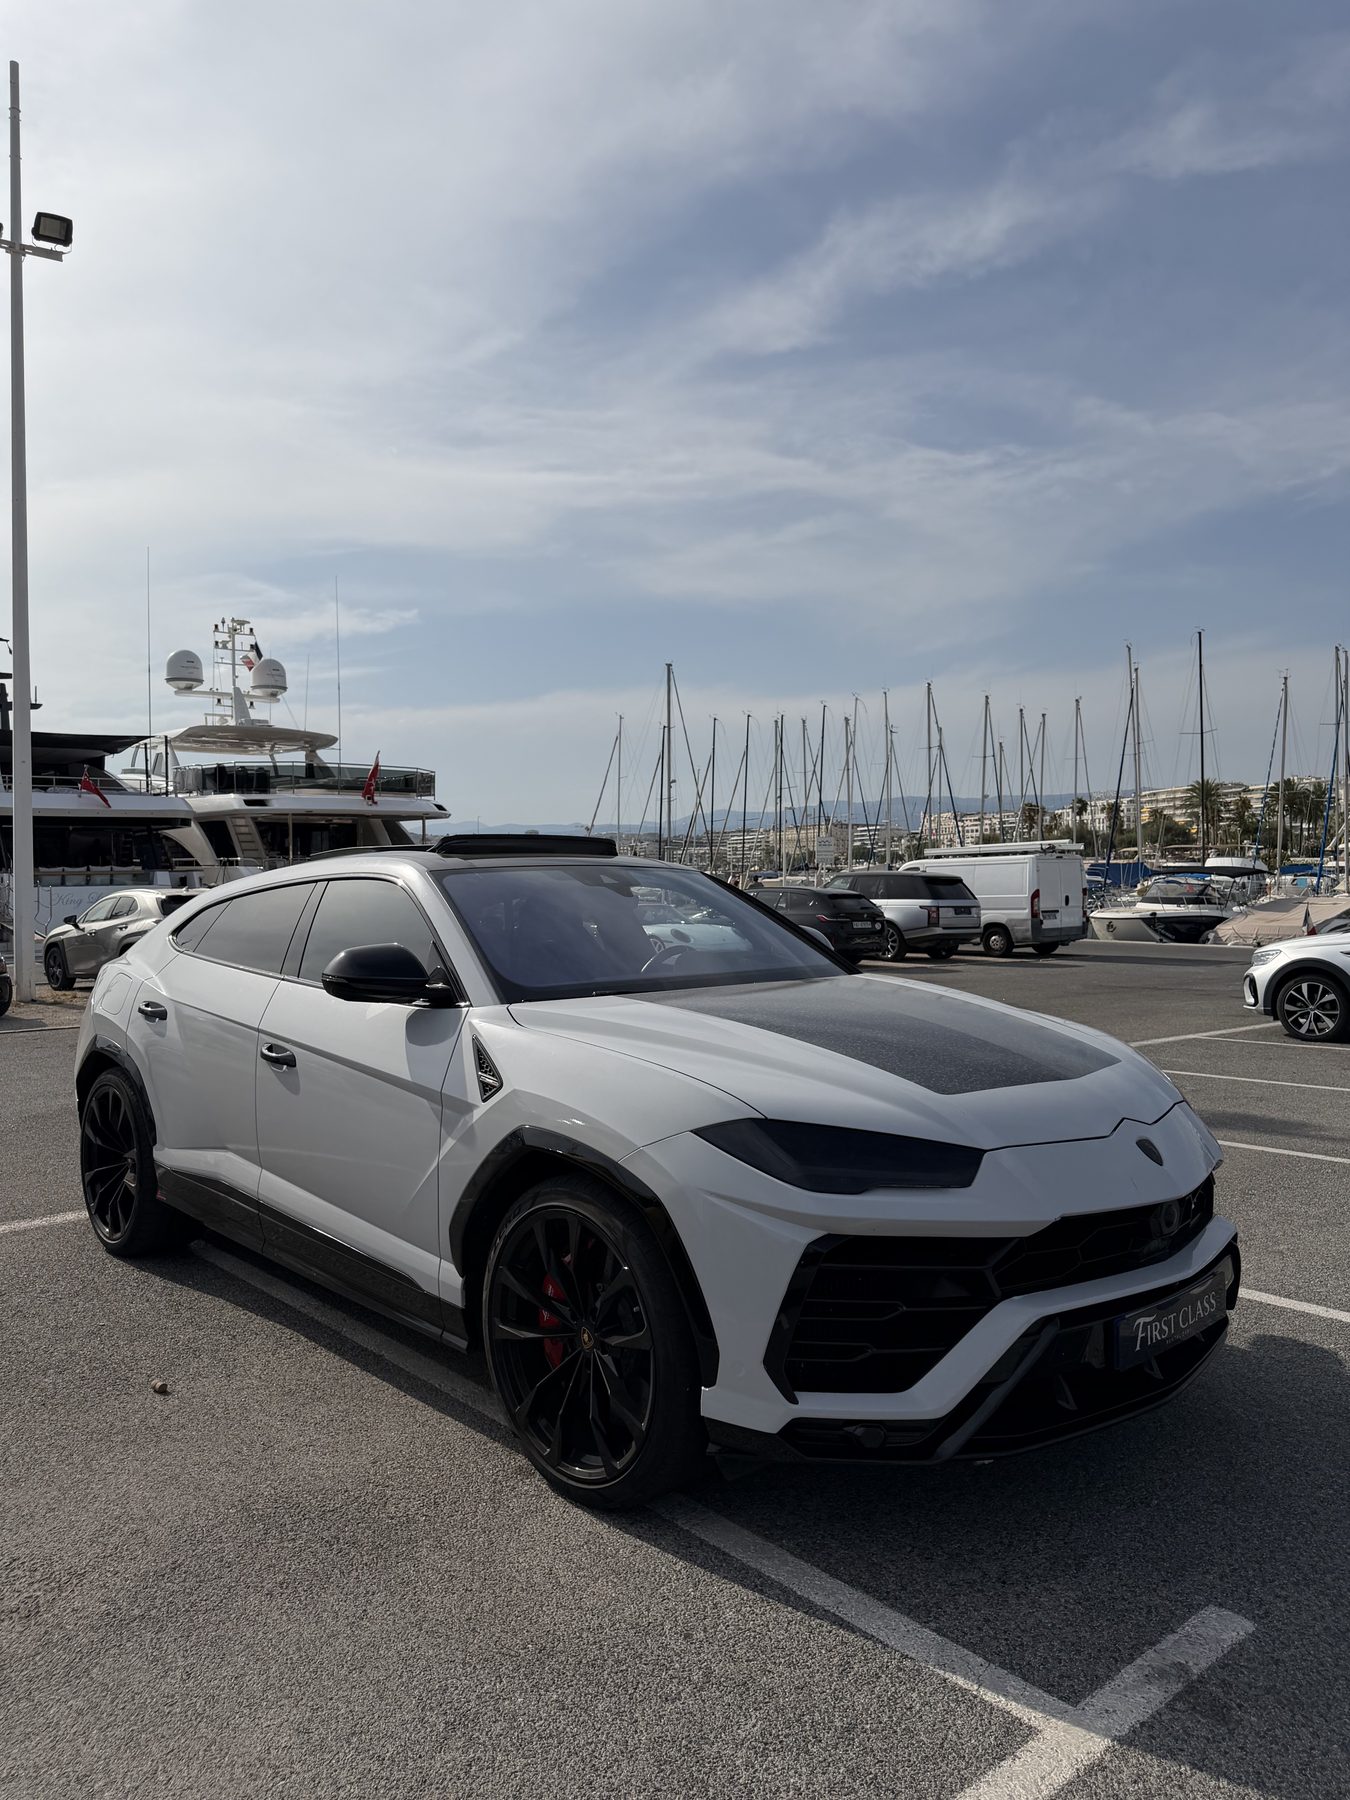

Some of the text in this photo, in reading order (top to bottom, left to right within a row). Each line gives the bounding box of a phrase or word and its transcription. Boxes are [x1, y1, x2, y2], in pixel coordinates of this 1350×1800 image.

[53, 893, 82, 908] King
[1133, 1313, 1177, 1352] FIRST
[1179, 1291, 1217, 1329] CLASS
